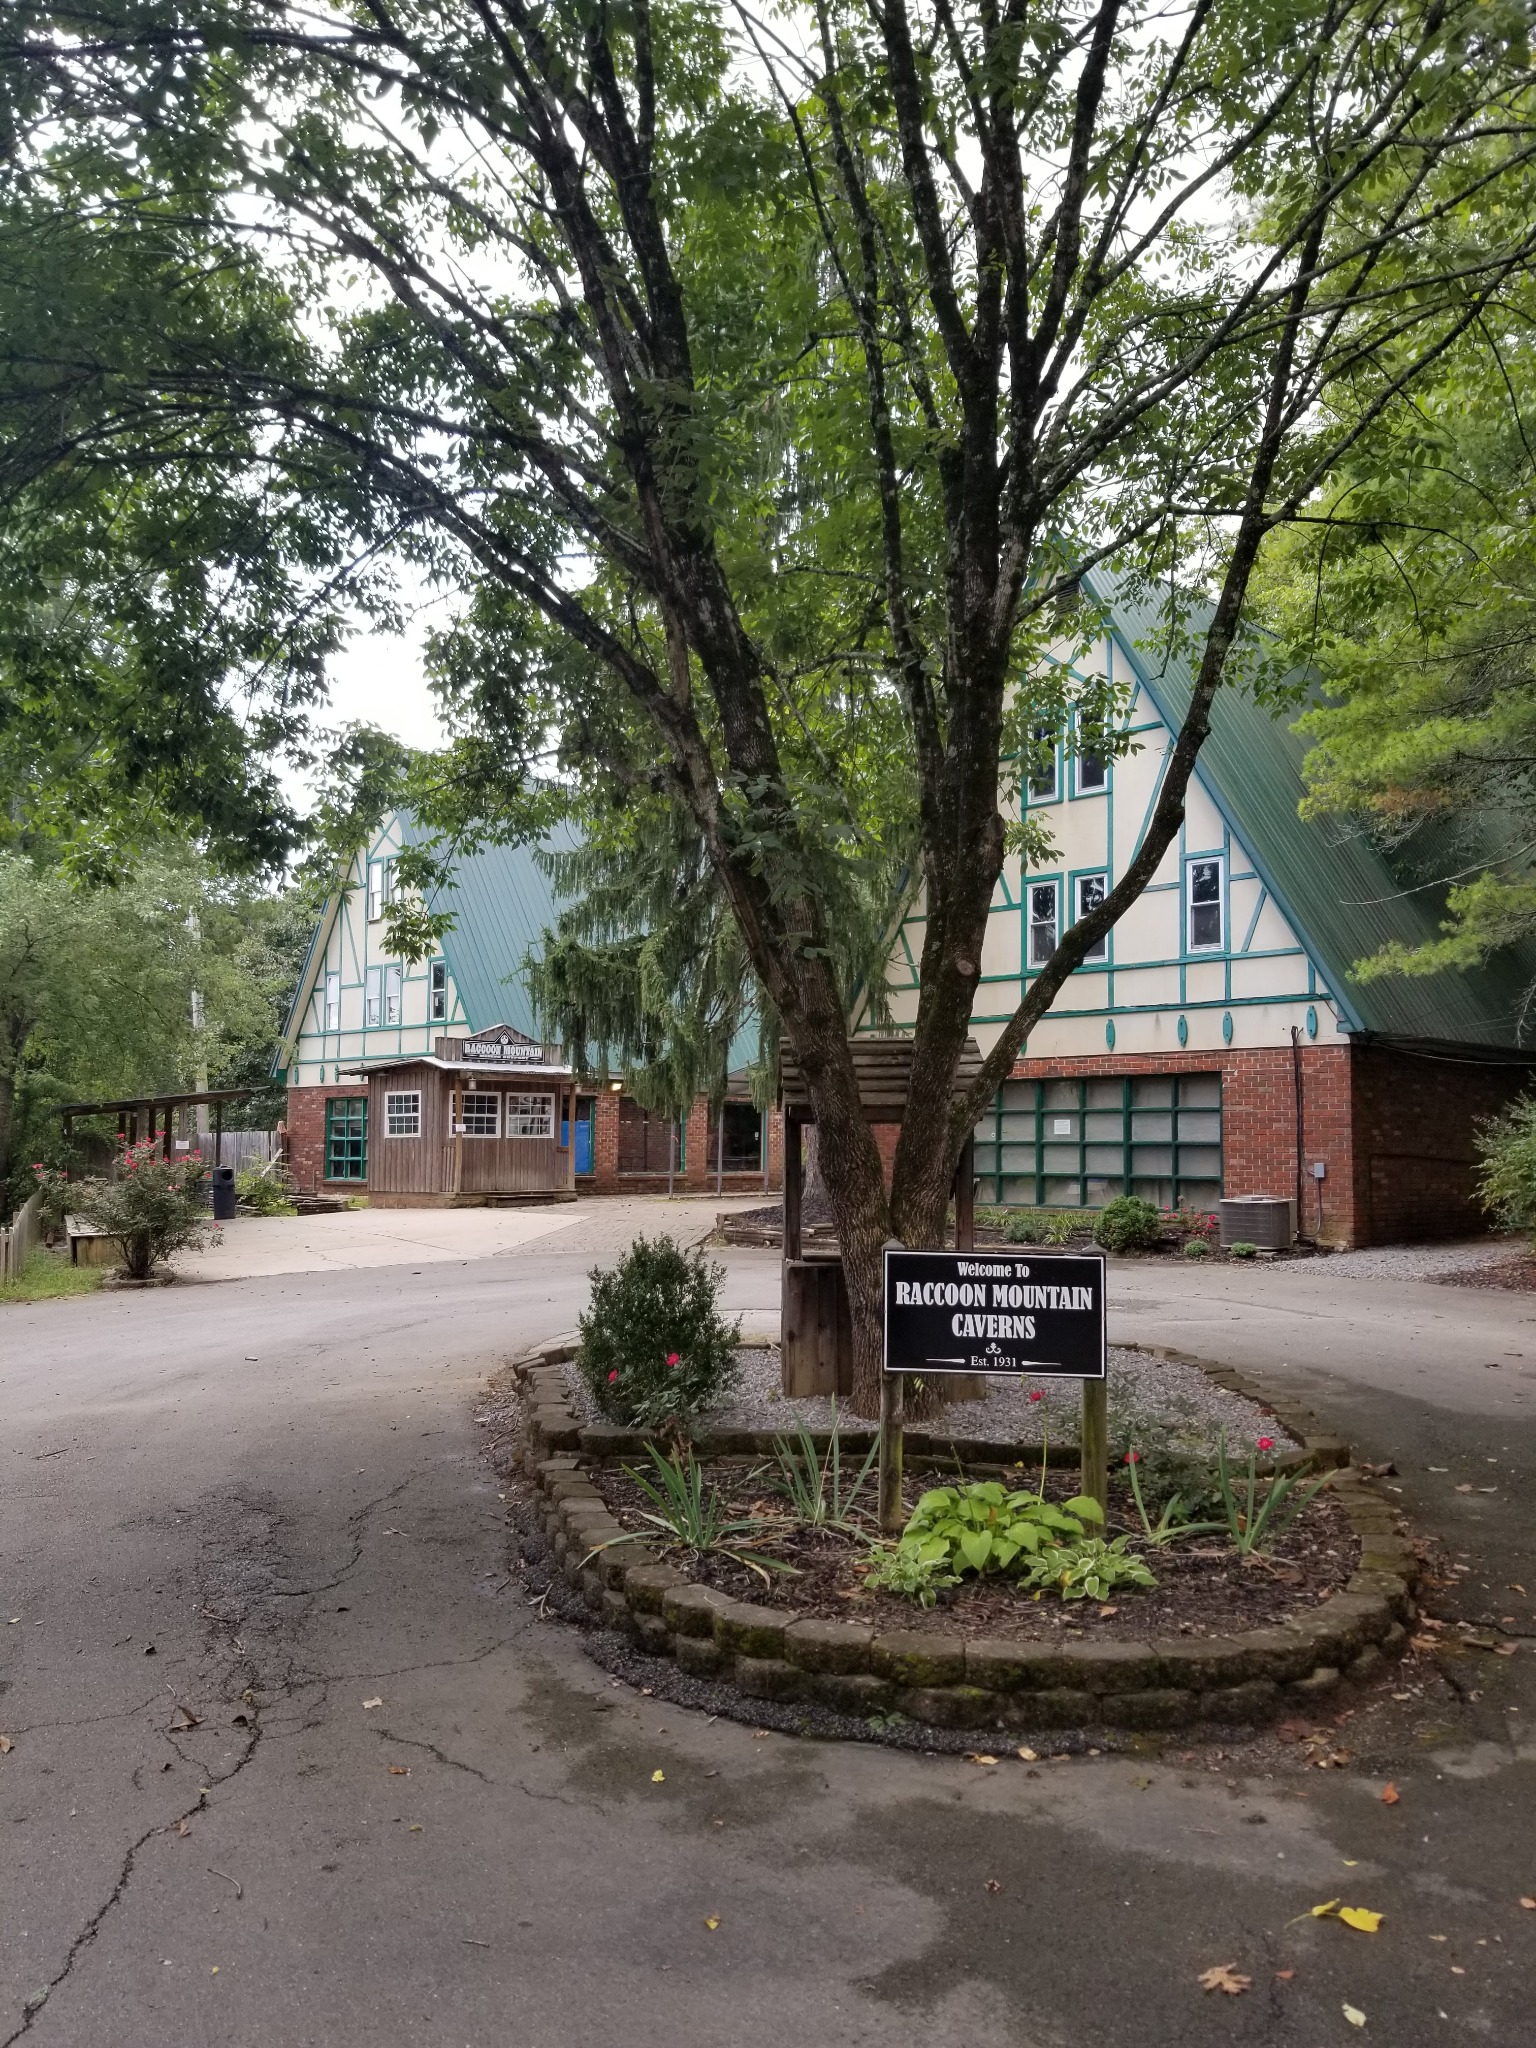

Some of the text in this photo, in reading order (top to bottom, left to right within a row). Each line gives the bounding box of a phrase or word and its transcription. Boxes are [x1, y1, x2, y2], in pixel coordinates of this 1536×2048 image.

[464, 1043, 502, 1055] RACCOON
[503, 1045, 543, 1057] MOUNTAIN
[957, 1261, 1030, 1278] Welcome To
[896, 1281, 1093, 1310] RACCOON MOUNTAIN
[951, 1313, 1036, 1339] CAVERNS
[970, 1355, 1017, 1367] Est. 1931
